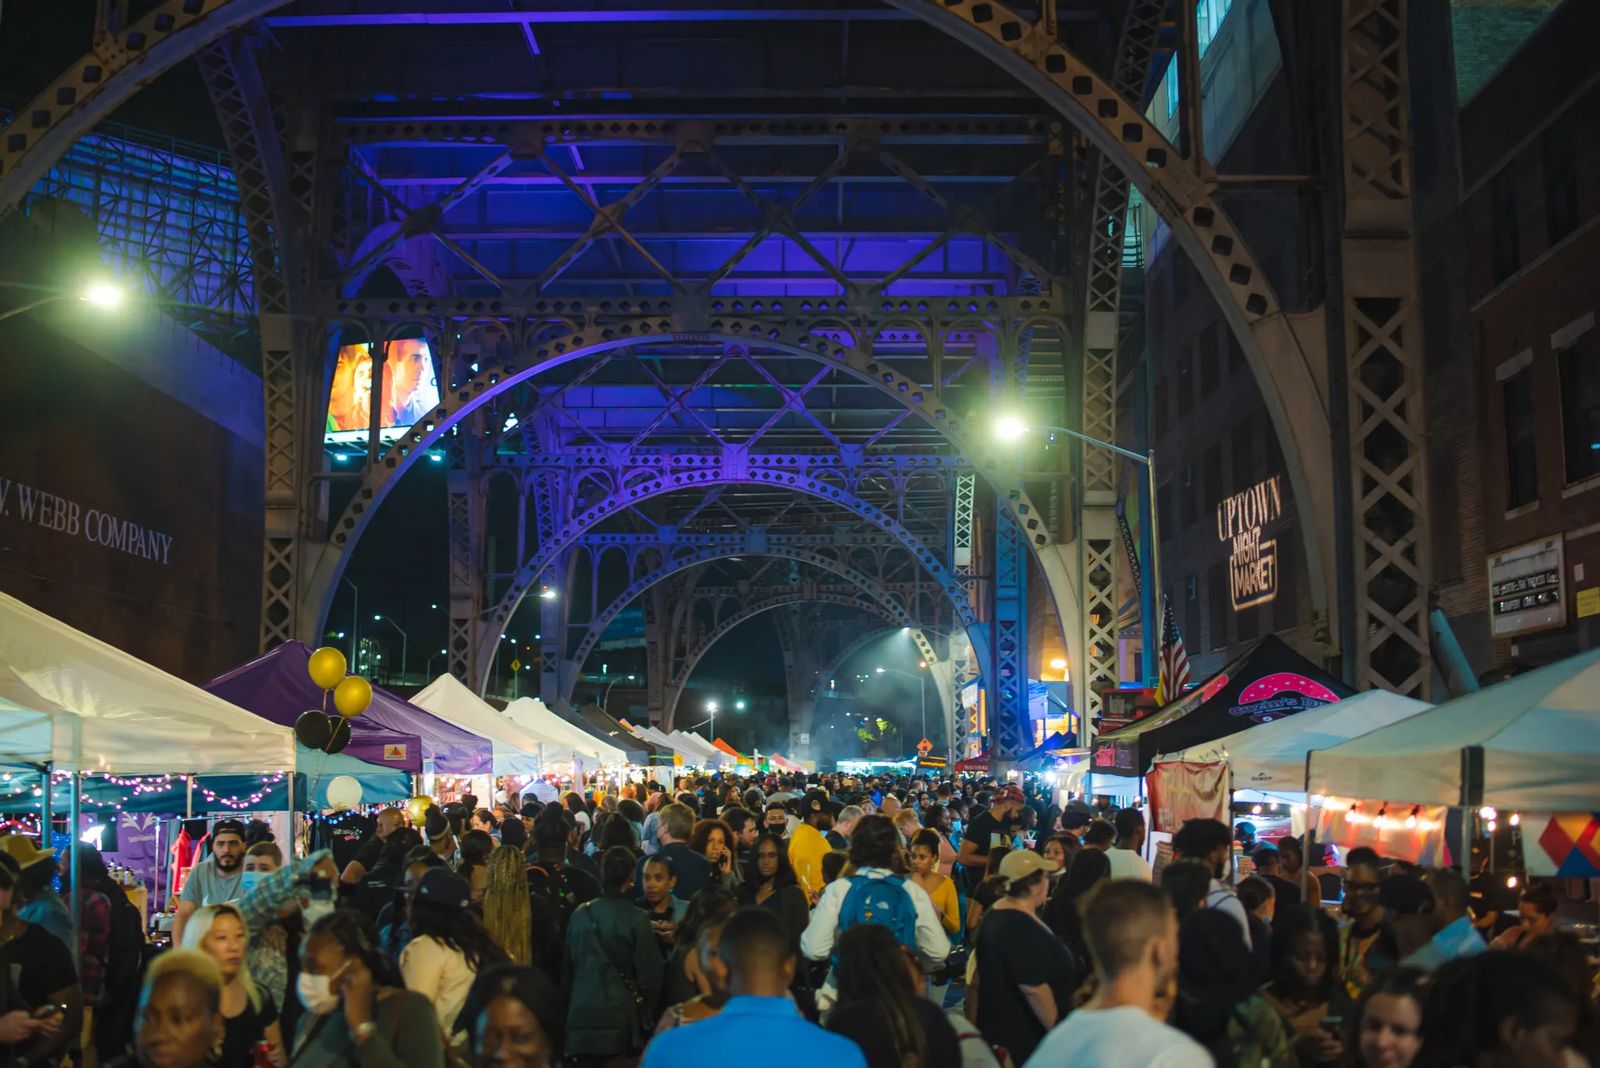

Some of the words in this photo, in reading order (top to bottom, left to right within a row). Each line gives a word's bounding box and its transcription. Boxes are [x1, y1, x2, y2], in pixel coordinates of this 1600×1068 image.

[17, 483, 80, 535] WEBB
[85, 509, 173, 565] COMPANY
[1217, 474, 1281, 541] UPTOWN
[1233, 526, 1260, 567] NIGHT
[1234, 555, 1274, 600] MARKET
